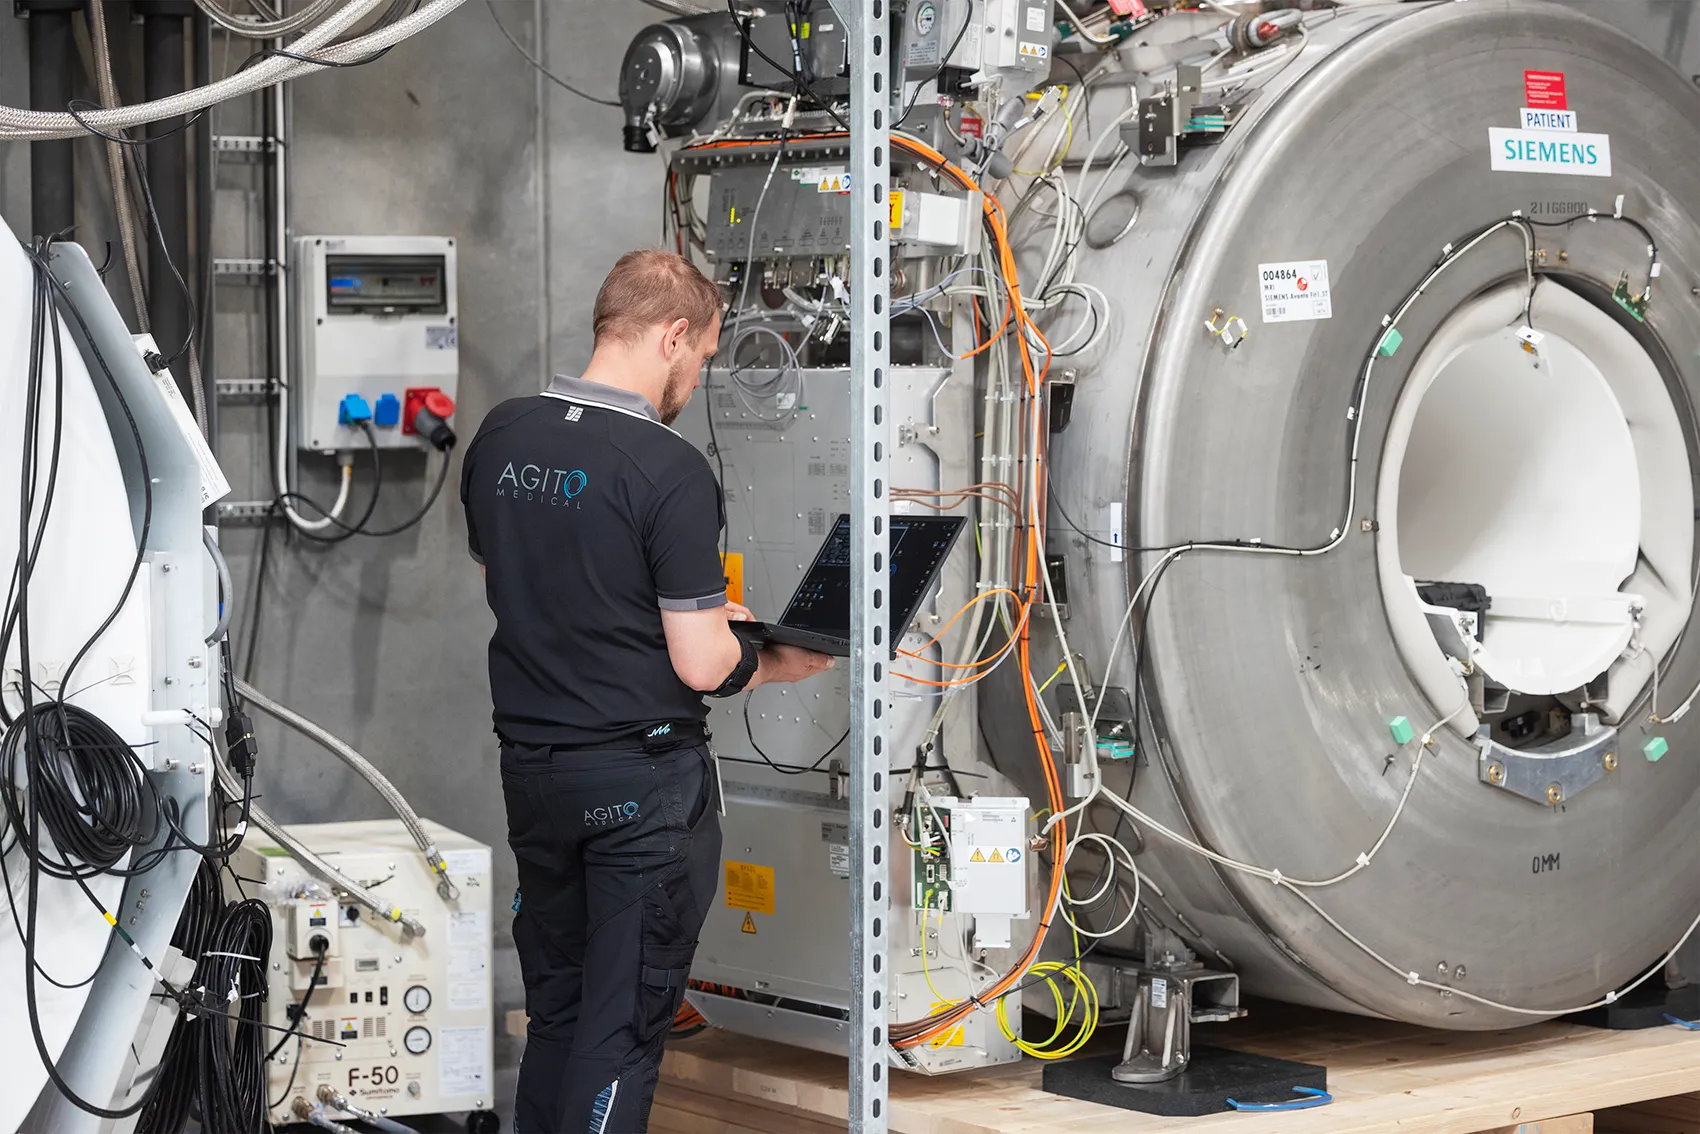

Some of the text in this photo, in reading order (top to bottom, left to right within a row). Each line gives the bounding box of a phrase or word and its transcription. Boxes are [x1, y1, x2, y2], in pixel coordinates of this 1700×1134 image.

[1526, 112, 1571, 128] PATIENT
[1504, 139, 1597, 165] SIEMENS
[1263, 269, 1297, 281] 004864
[1265, 293, 1289, 301] SIEMENS
[497, 461, 587, 498] AGITO
[496, 488, 581, 509] MEDICAL
[584, 801, 639, 822] AGITO
[585, 813, 641, 826] MEDICAL
[348, 1065, 399, 1087] F-50
